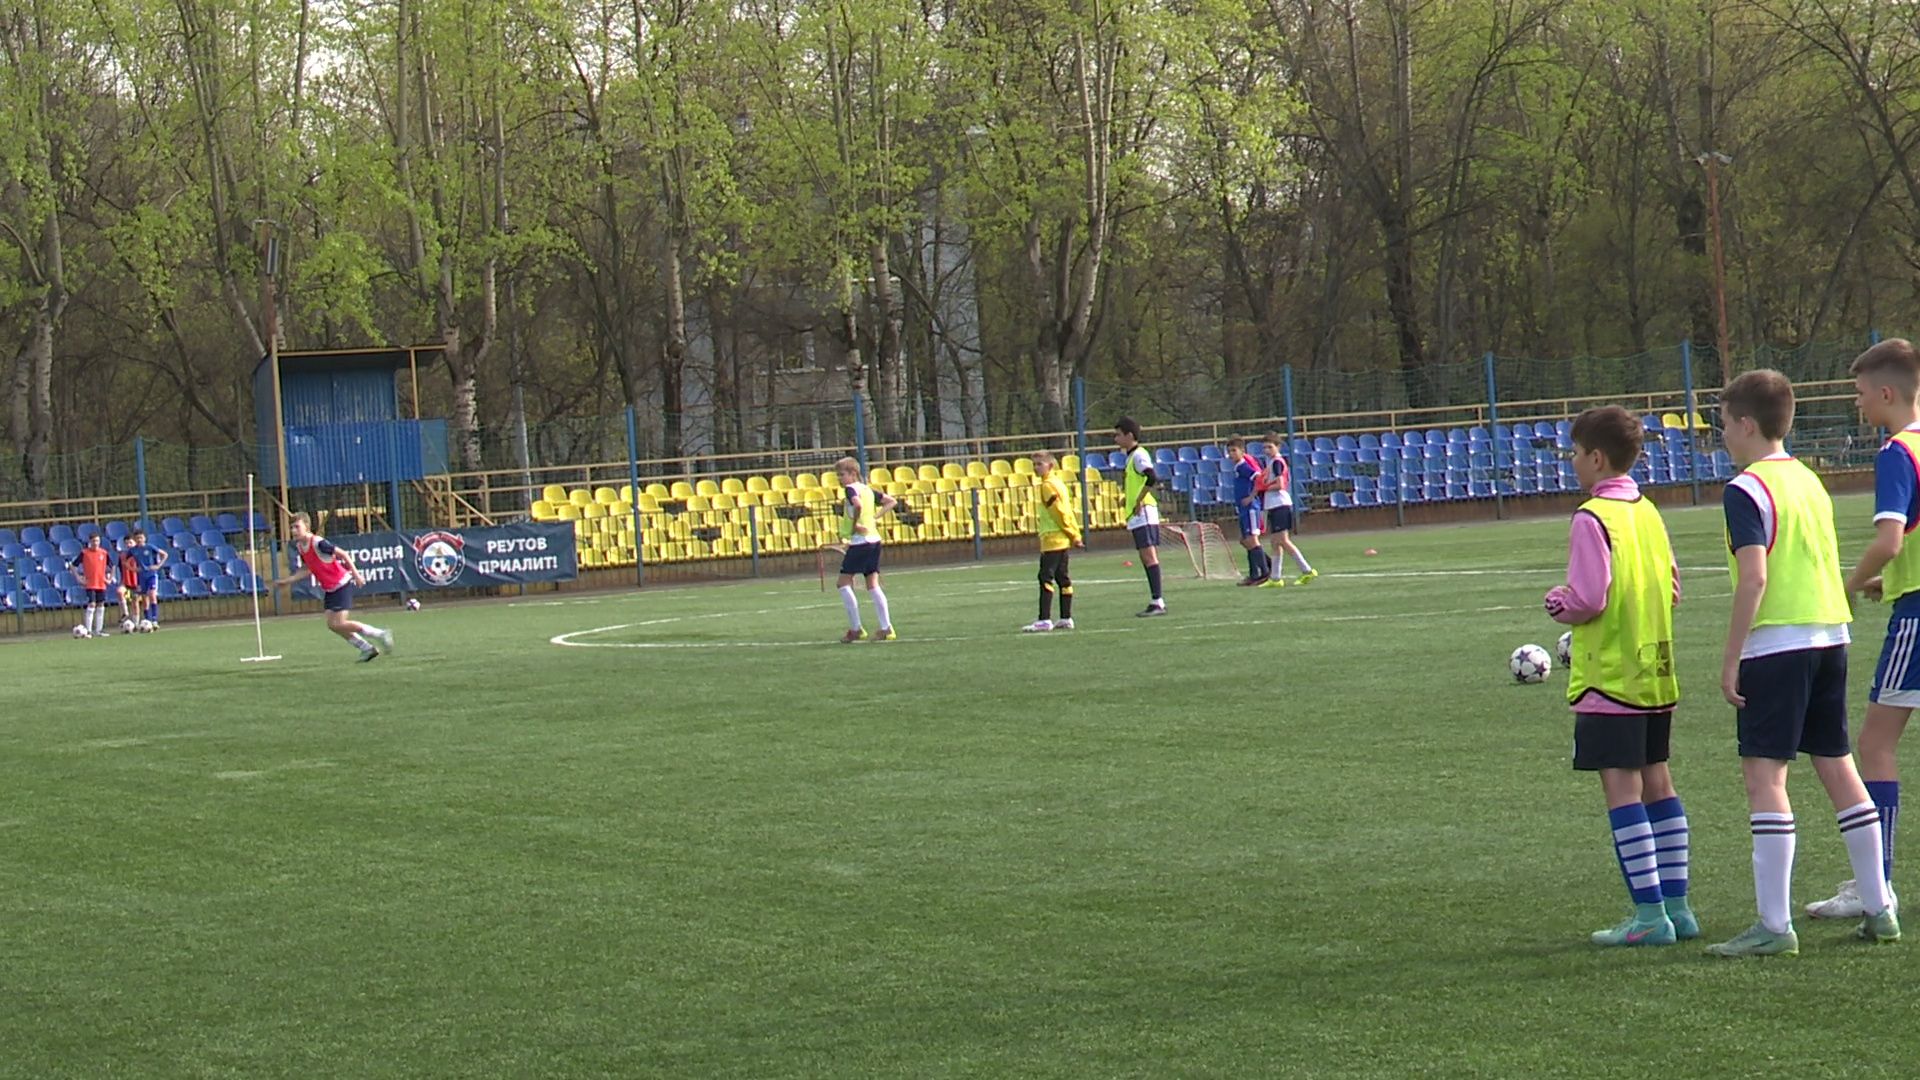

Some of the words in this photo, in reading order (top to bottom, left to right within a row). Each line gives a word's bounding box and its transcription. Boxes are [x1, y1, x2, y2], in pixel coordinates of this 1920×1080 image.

[338, 545, 404, 564] ГОДНЯ
[486, 537, 548, 554] РЕУТОВ
[478, 556, 558, 574] ПРИАЛИТ!
